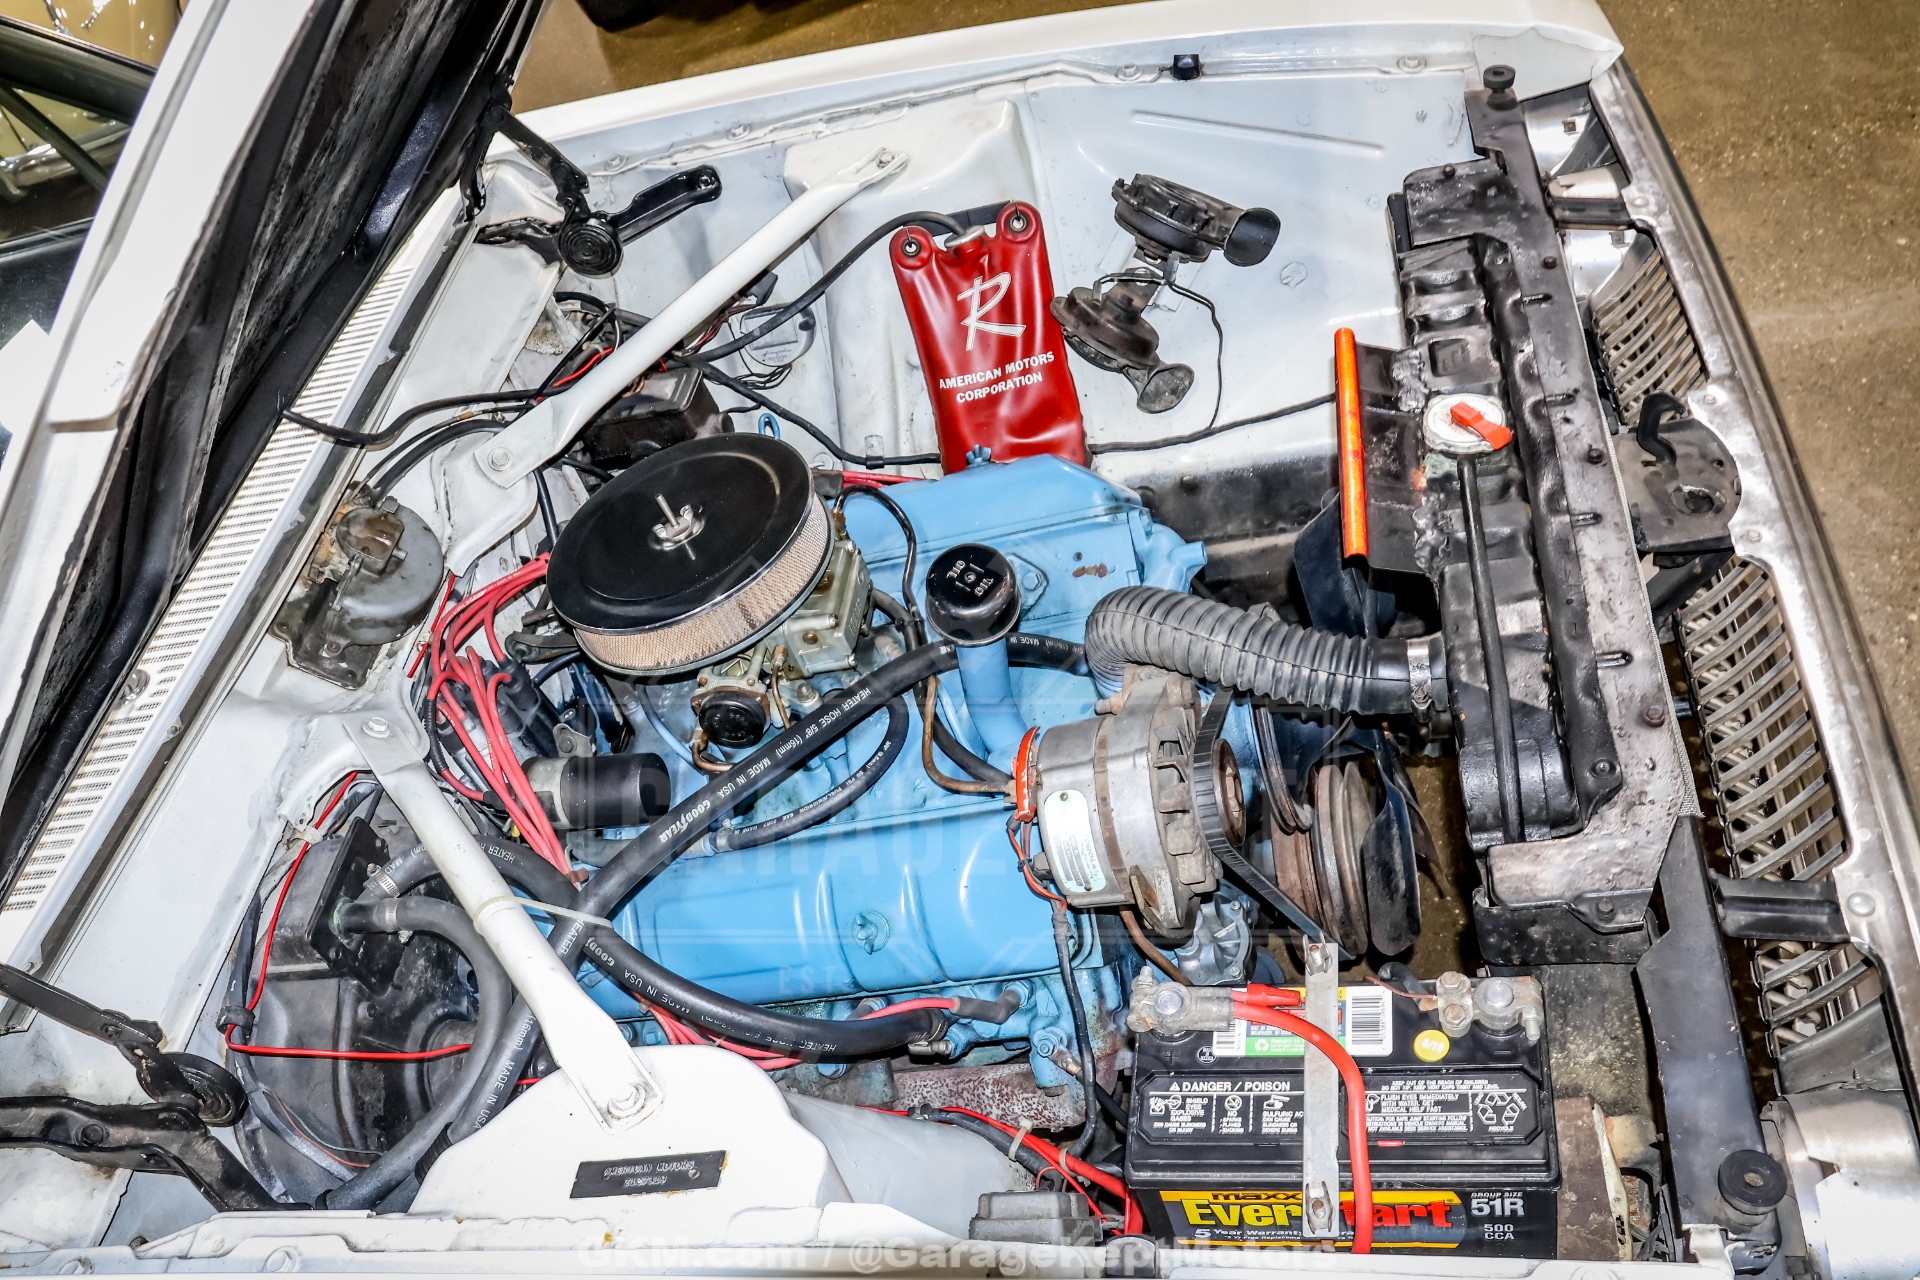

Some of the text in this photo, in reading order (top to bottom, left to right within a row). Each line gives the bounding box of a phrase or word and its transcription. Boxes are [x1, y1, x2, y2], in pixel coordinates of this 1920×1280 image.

[957, 271, 1027, 351] R
[939, 350, 1055, 390] AMERICAN MOTORS
[956, 371, 1043, 404] CORPORATION
[1010, 636, 1018, 644] IN
[1020, 636, 1040, 646] MADE
[844, 687, 872, 711] HEATER
[818, 709, 842, 727] HOSE
[775, 734, 803, 758] (16mm)
[748, 757, 771, 778] MADE
[735, 773, 748, 787] IN
[716, 782, 736, 799] USA
[658, 799, 712, 844] GOODYEAR
[487, 844, 516, 866] HEATER
[624, 969, 643, 988] USA
[646, 985, 658, 997] IN
[472, 1015, 537, 1129] (16mm) MADE IN USA
[1182, 1081, 1232, 1092] DANGER
[1244, 1081, 1291, 1092] POISON
[1170, 1109, 1205, 1117] EXPLOSIVE
[1180, 1199, 1453, 1228] Evertart
[1470, 1198, 1526, 1217] 51R
[1194, 1228, 1211, 1239] 5
[1483, 1224, 1514, 1232] 500
[1484, 1232, 1515, 1240] CCA
